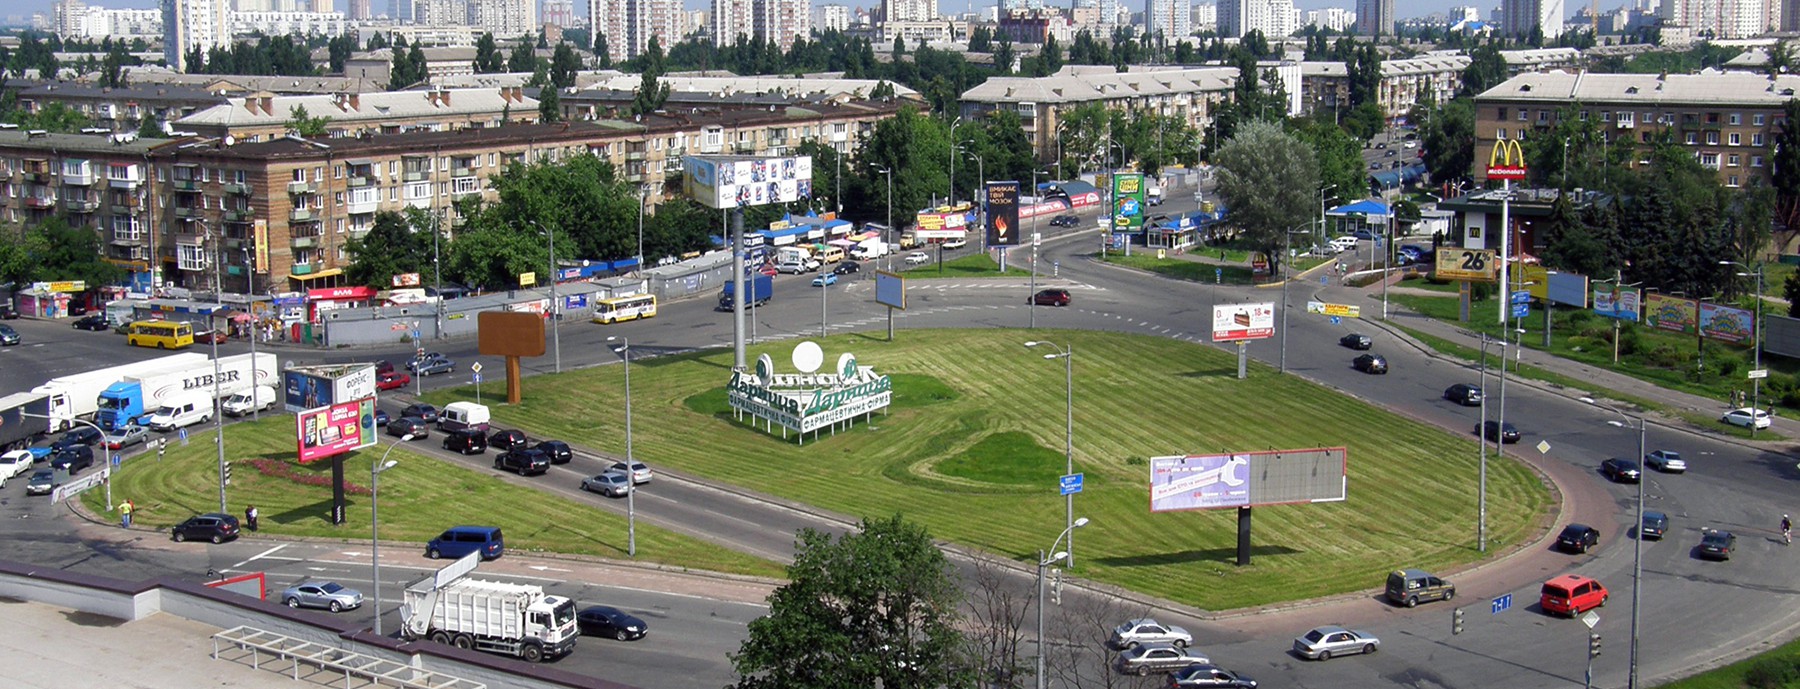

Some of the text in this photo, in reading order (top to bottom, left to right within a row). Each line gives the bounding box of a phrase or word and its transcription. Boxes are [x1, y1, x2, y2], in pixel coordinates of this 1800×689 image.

[183, 370, 240, 390] LIBER
[727, 369, 800, 417] Дарниця
[804, 375, 891, 417] Дарниця
[729, 393, 779, 422] ФАРМАЦЕВТИЧНА
[803, 394, 889, 430] ФАРМАЦЕВТИЧНА ФІРМА
